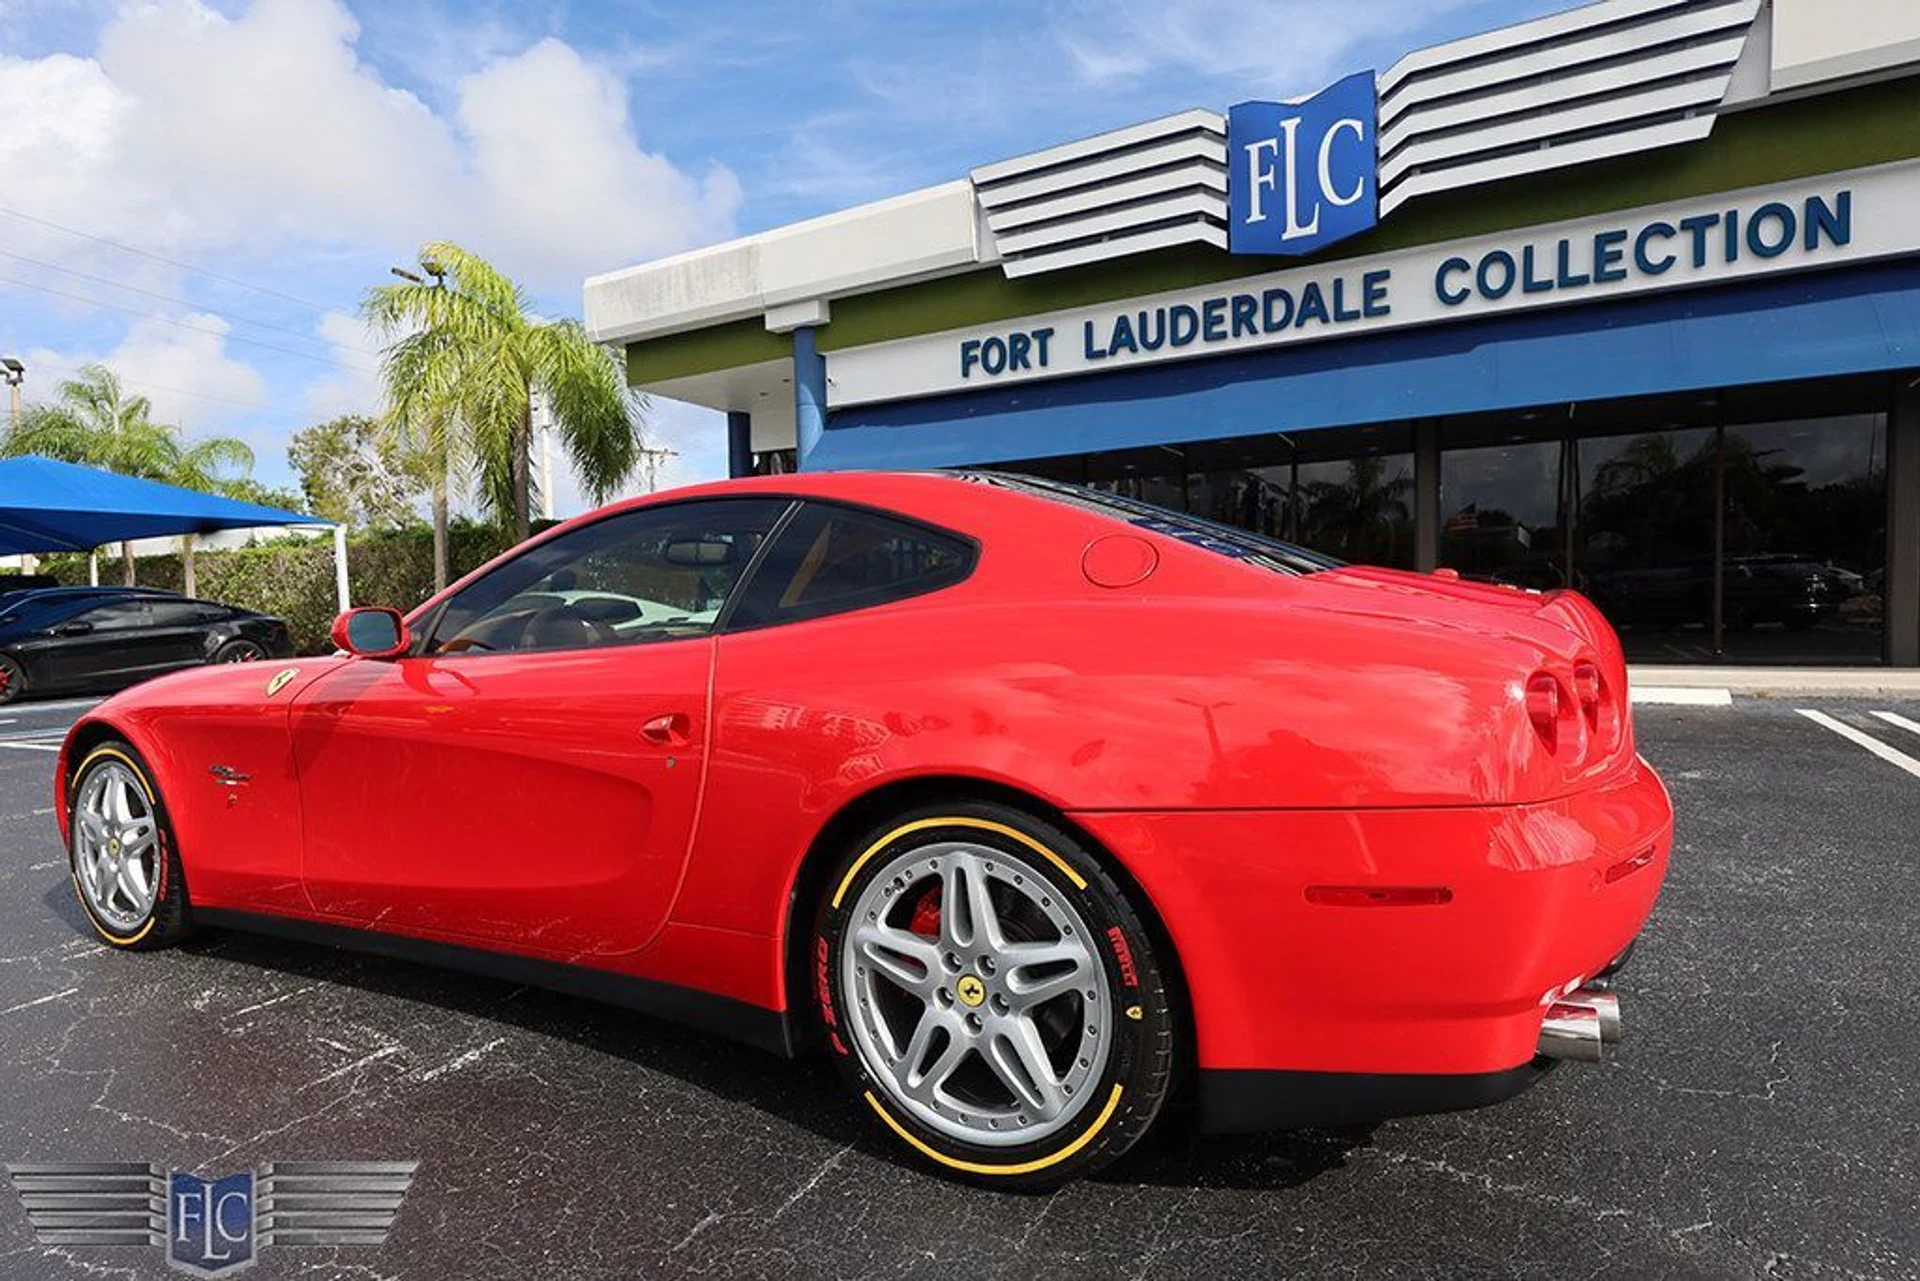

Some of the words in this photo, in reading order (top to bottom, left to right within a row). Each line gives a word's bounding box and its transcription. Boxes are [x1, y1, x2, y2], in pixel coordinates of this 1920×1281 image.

[1245, 117, 1364, 241] FLC
[961, 328, 1054, 378] FORT
[1084, 270, 1391, 360] LAUDERDALE
[1435, 190, 1852, 306] COLLECTION
